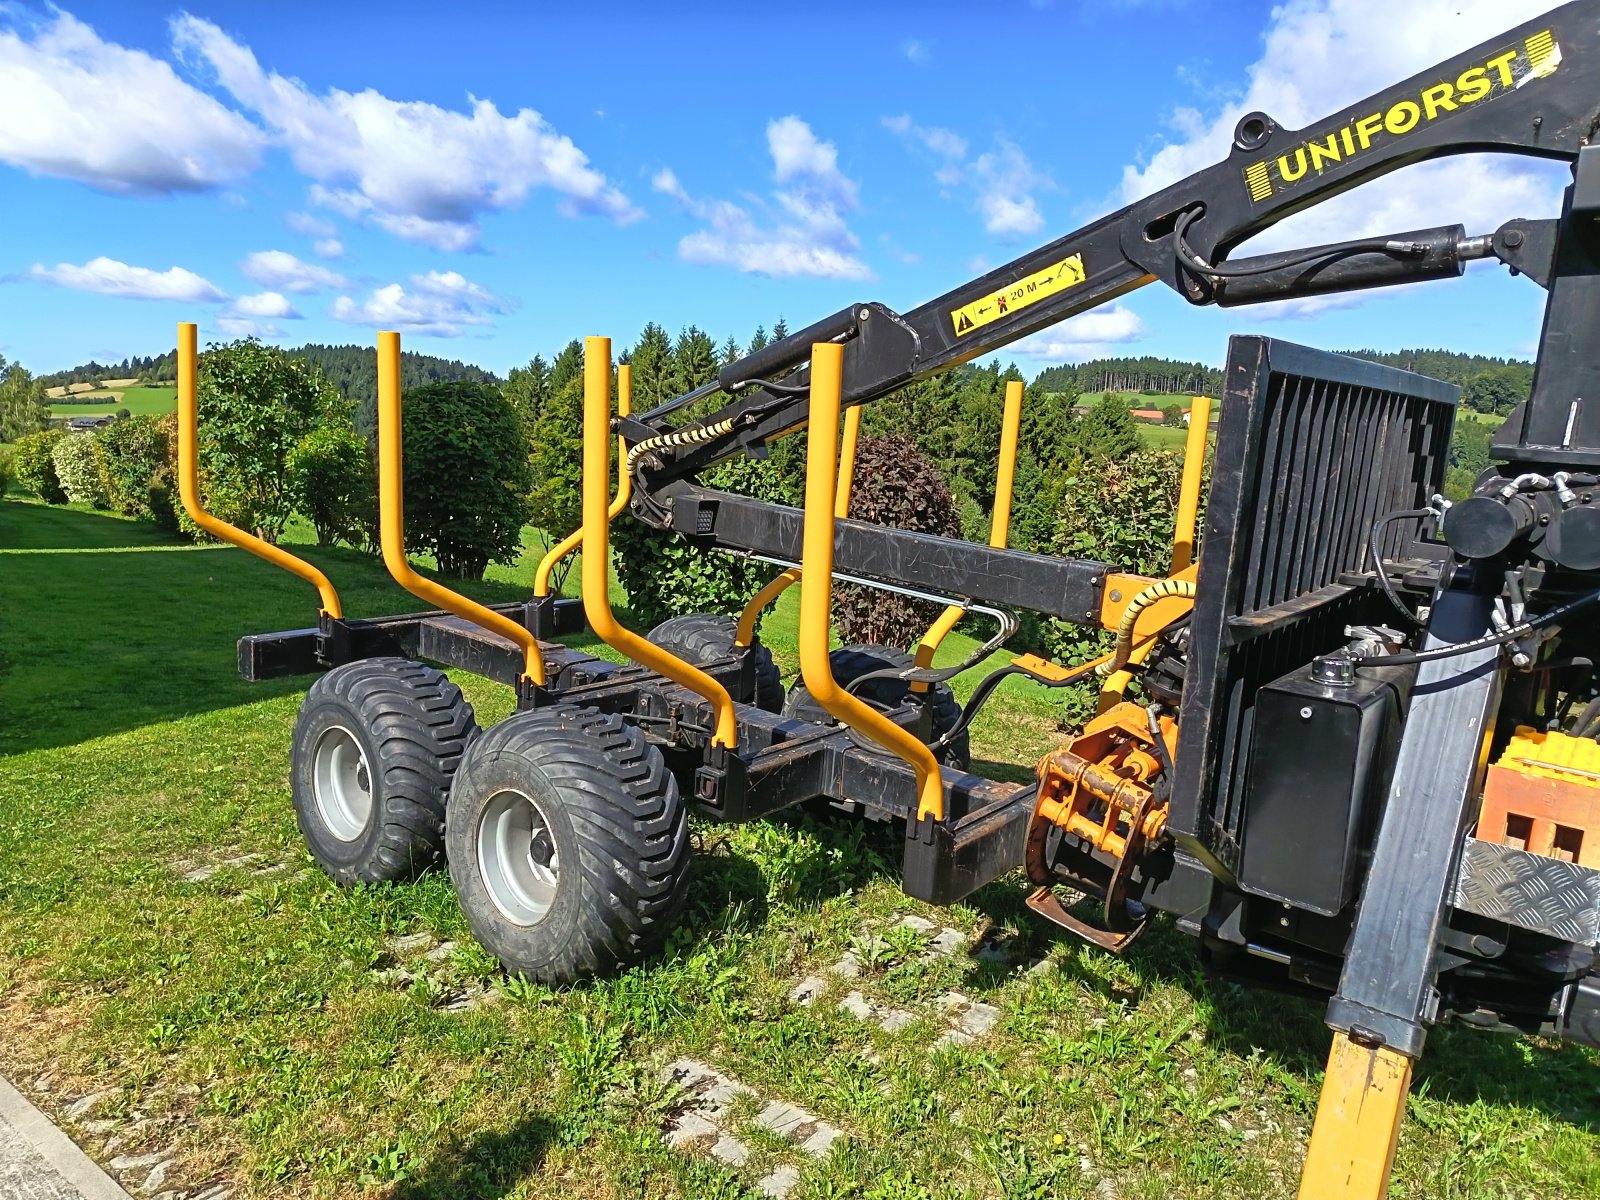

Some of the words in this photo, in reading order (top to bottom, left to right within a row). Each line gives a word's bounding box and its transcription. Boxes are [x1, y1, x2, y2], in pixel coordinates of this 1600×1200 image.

[1277, 50, 1517, 182] UNIFORST
[1011, 288, 1024, 301] 20
[1026, 282, 1037, 293] M
